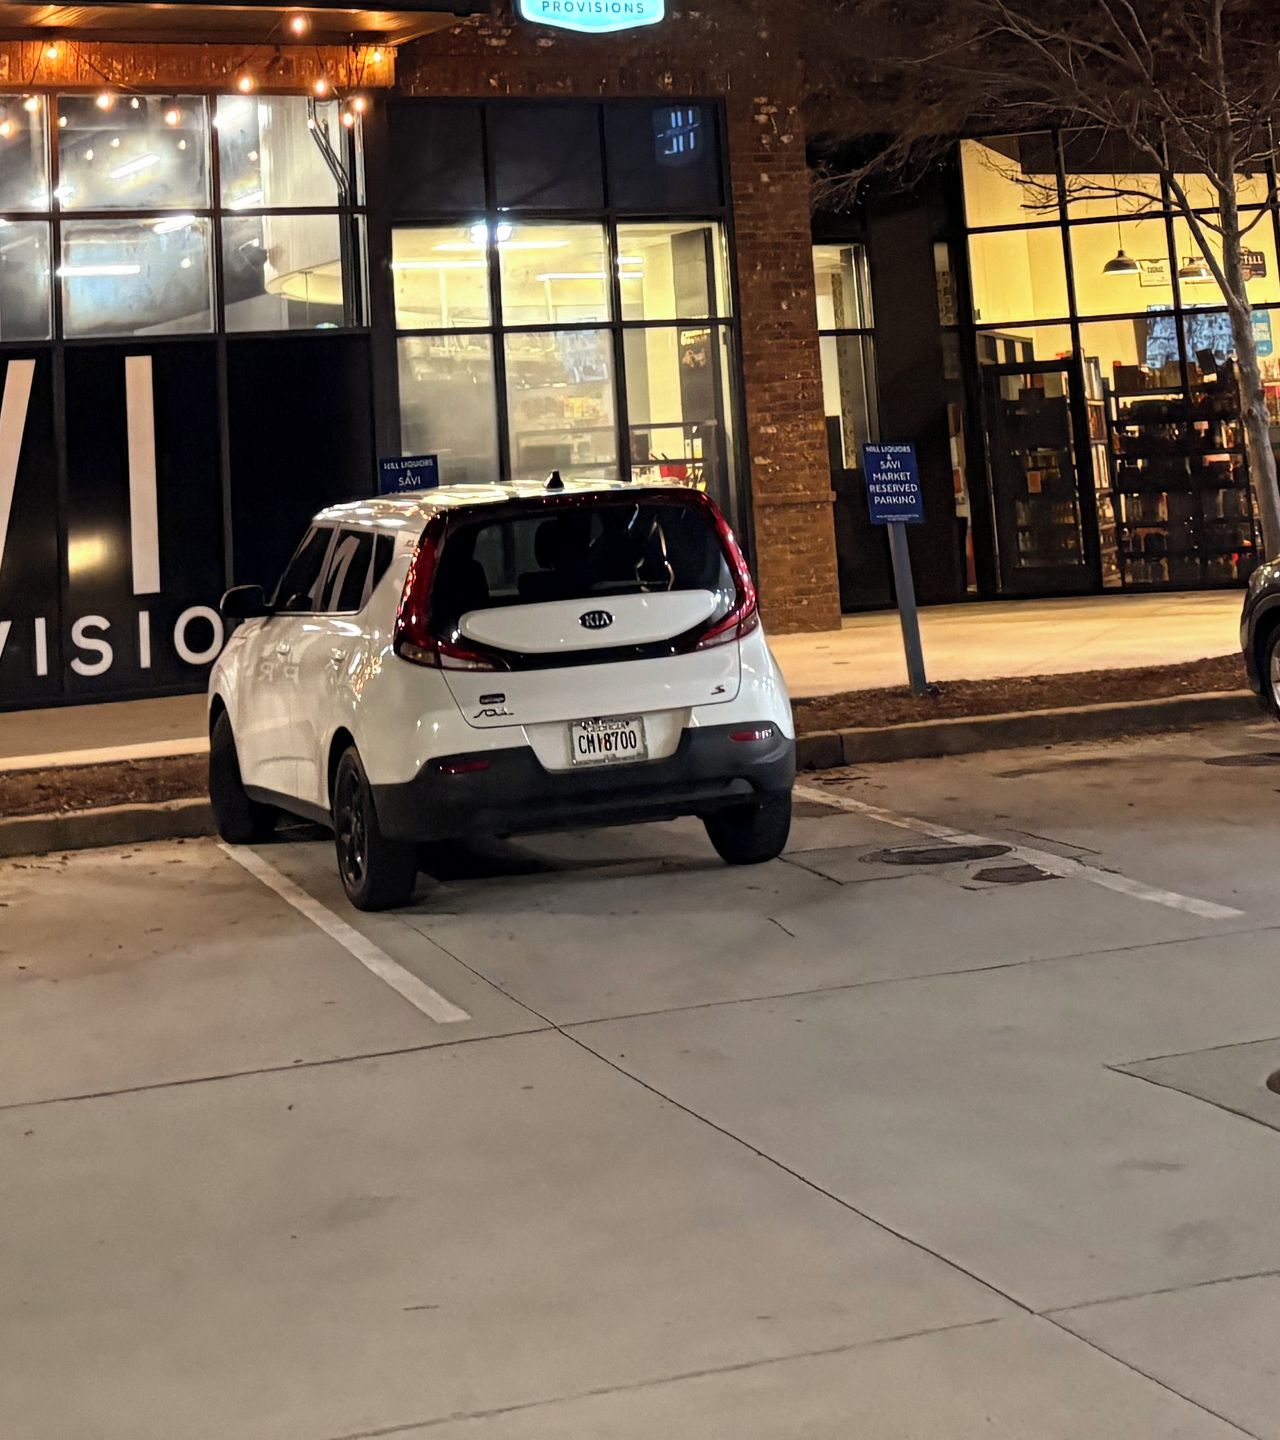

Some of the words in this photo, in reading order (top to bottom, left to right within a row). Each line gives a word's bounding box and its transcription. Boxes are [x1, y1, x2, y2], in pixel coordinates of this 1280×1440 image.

[542, 1, 645, 14] PROVISIONS
[880, 461, 900, 469] SAVI
[399, 476, 421, 486] SAVI
[872, 471, 910, 481] MARKET
[869, 484, 917, 493] RESERVED
[874, 495, 916, 504] PARKING
[584, 613, 610, 627] KIA
